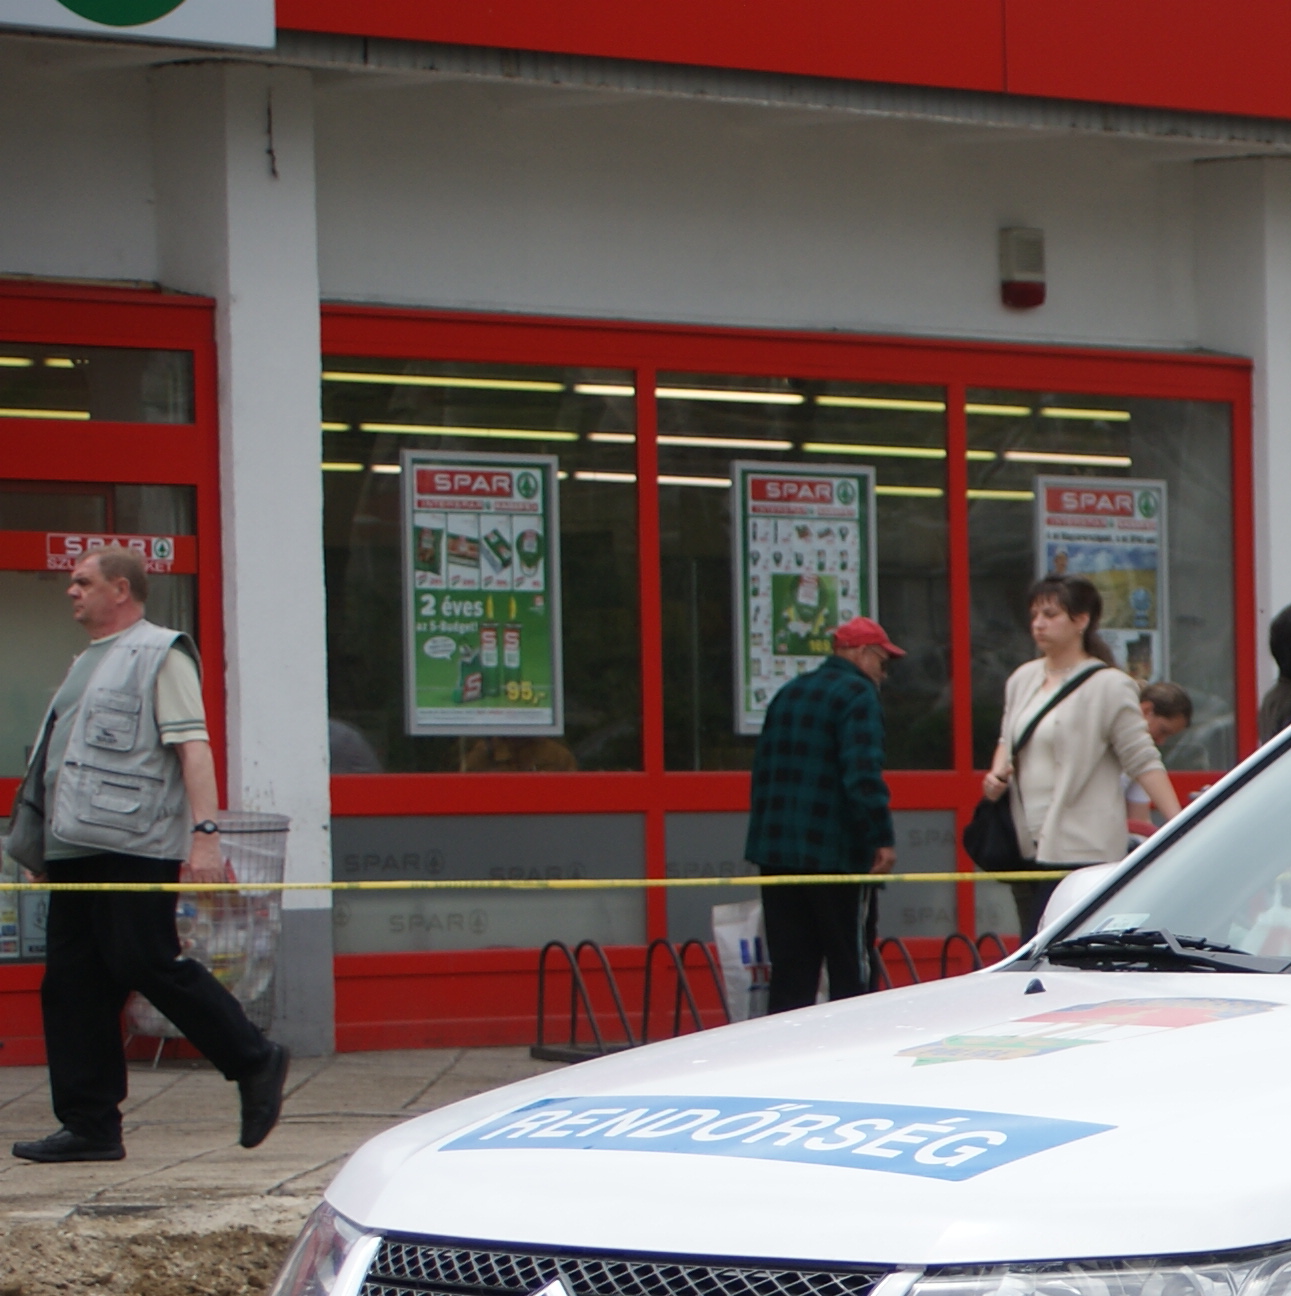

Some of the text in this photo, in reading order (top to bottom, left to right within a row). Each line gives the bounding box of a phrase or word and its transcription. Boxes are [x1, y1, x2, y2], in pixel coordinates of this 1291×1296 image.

[434, 473, 511, 493] SPAR
[766, 481, 832, 500] SPAR
[1061, 491, 1133, 512] SPAR
[420, 593, 484, 617] 2 éves
[343, 852, 421, 873] SPAR
[388, 913, 465, 933] SPAR
[479, 1103, 1007, 1168] RENDŐRSÉG
